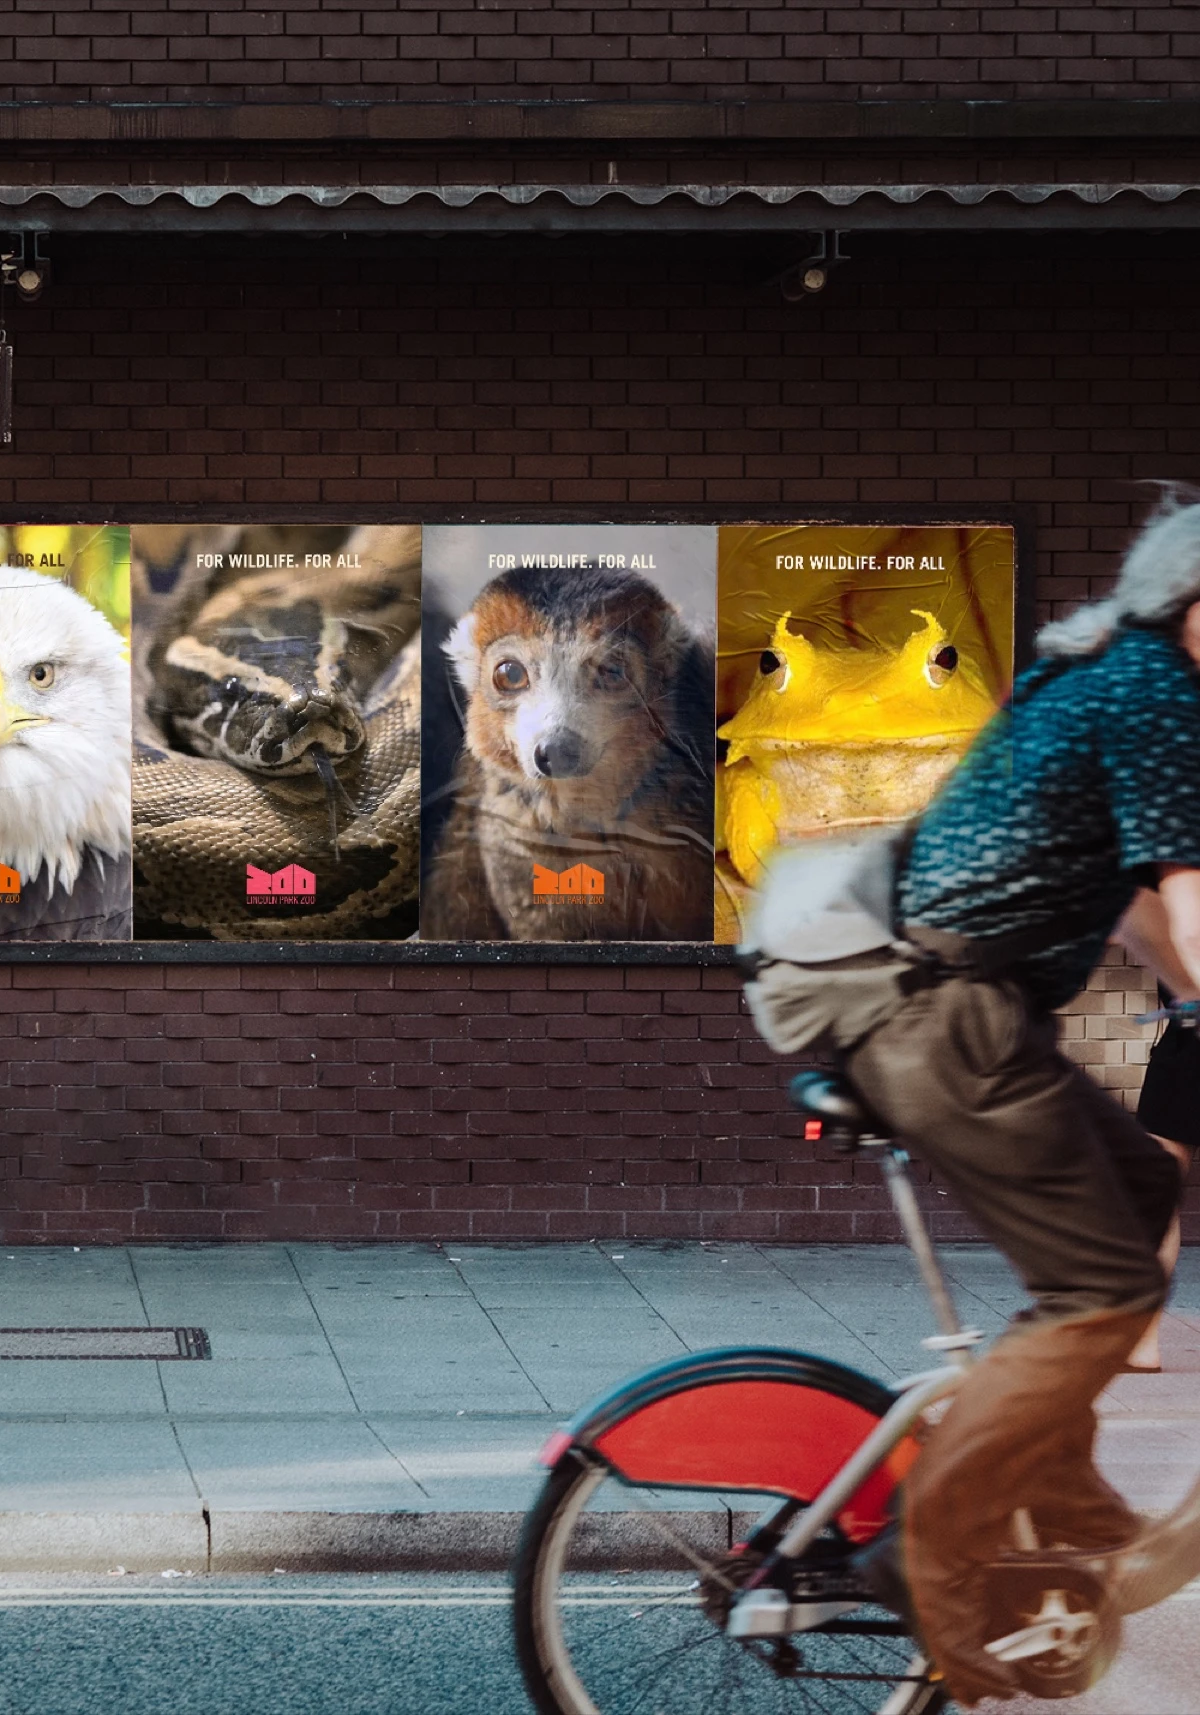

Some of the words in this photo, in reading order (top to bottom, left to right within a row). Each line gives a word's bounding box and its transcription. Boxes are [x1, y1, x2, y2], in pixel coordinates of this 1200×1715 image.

[7, 553, 34, 567] FOR
[39, 553, 65, 567] ALL
[196, 554, 223, 568] FOR
[228, 554, 299, 568] WILDLIFE.
[304, 554, 331, 568] FOR
[336, 554, 362, 568] ALL
[488, 554, 515, 568] FOR
[521, 554, 593, 568] WILDLIFE.
[598, 554, 625, 568] FOR
[630, 554, 657, 568] ALL
[775, 555, 804, 570] FOR
[809, 555, 881, 570] WILDLIFE.
[887, 555, 915, 570] FOR
[919, 555, 945, 570] ALL
[246, 863, 316, 895] ZOO
[533, 863, 605, 895] ZOO
[280, 896, 298, 904] PARK
[567, 895, 586, 904] PARK
